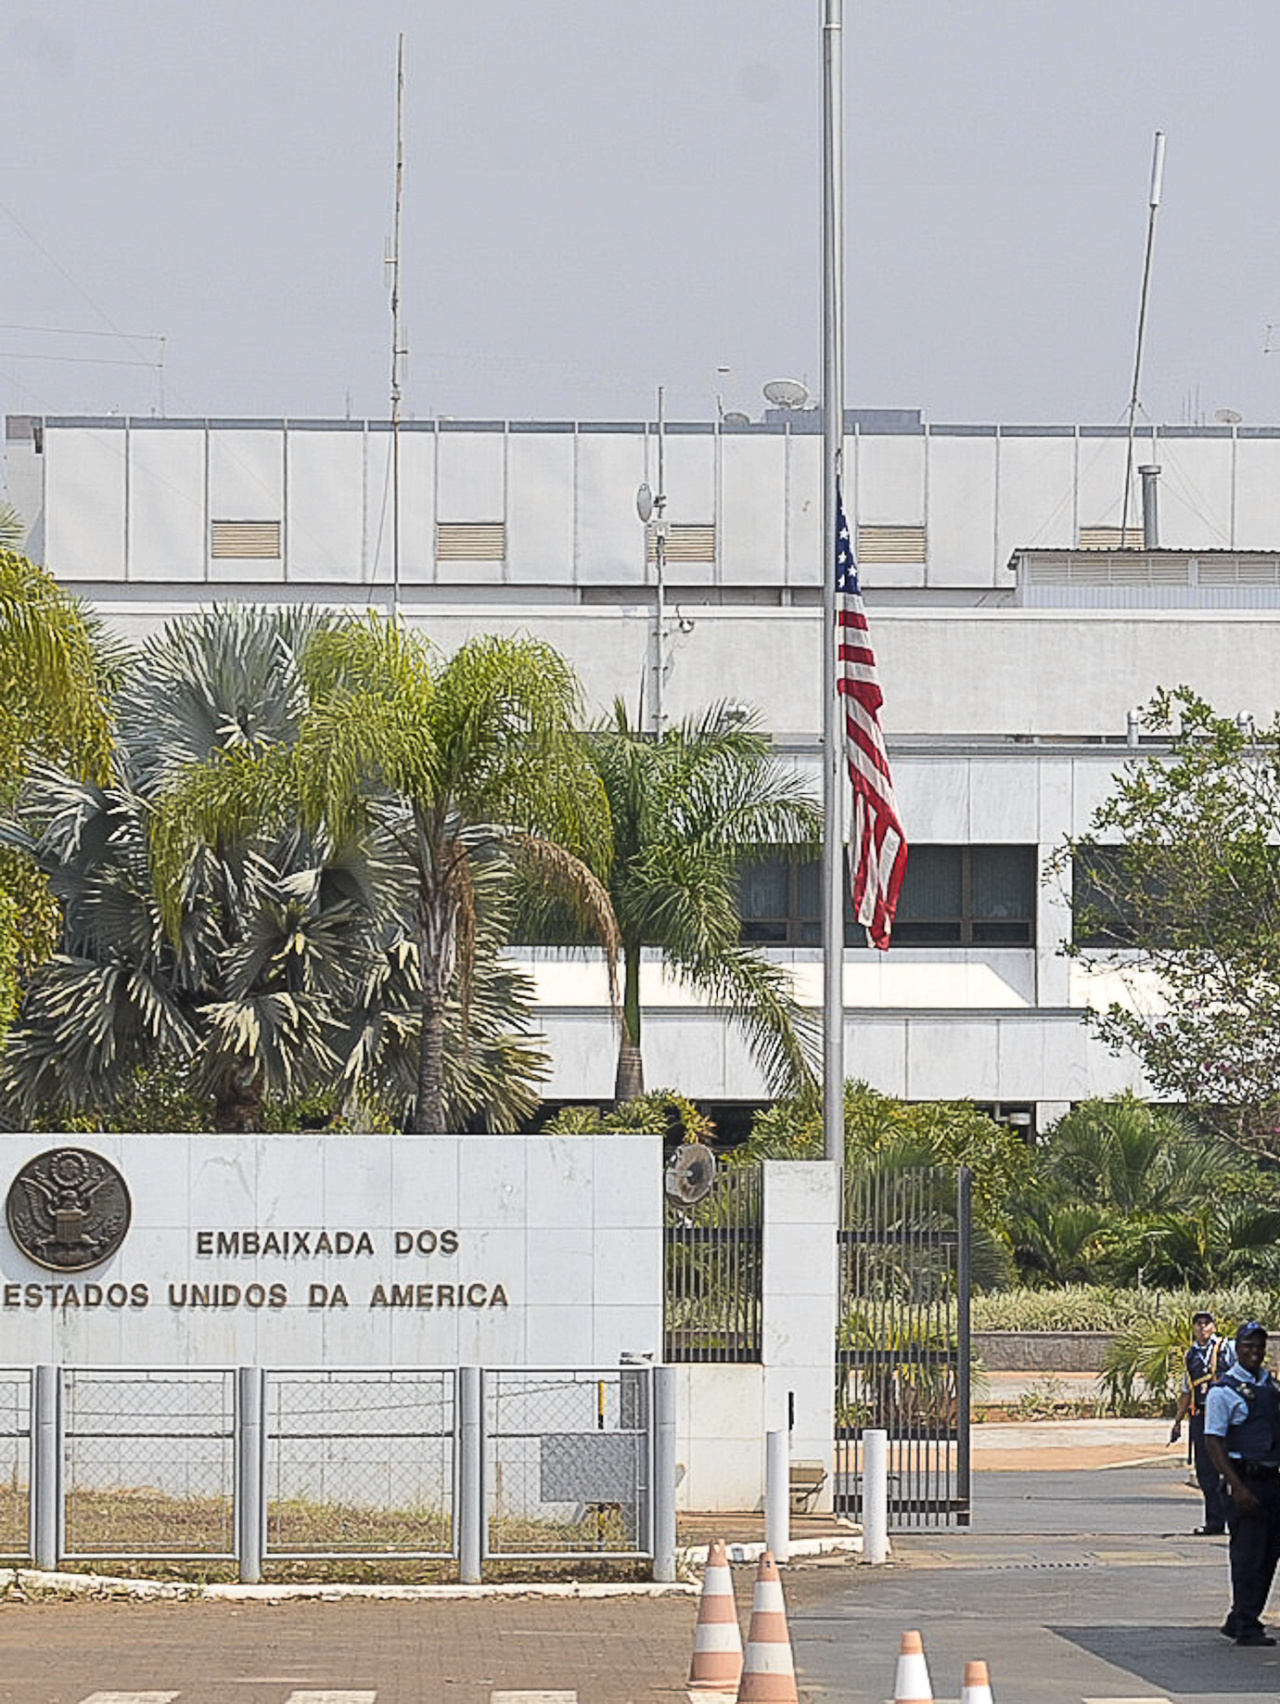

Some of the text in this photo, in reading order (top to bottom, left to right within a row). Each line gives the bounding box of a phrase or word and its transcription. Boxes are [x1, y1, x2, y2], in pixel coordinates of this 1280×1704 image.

[196, 1229, 459, 1256] EMBAIXADA DOS
[3, 1282, 509, 1308] ESTADOS UNIDOS DA AMERICA
